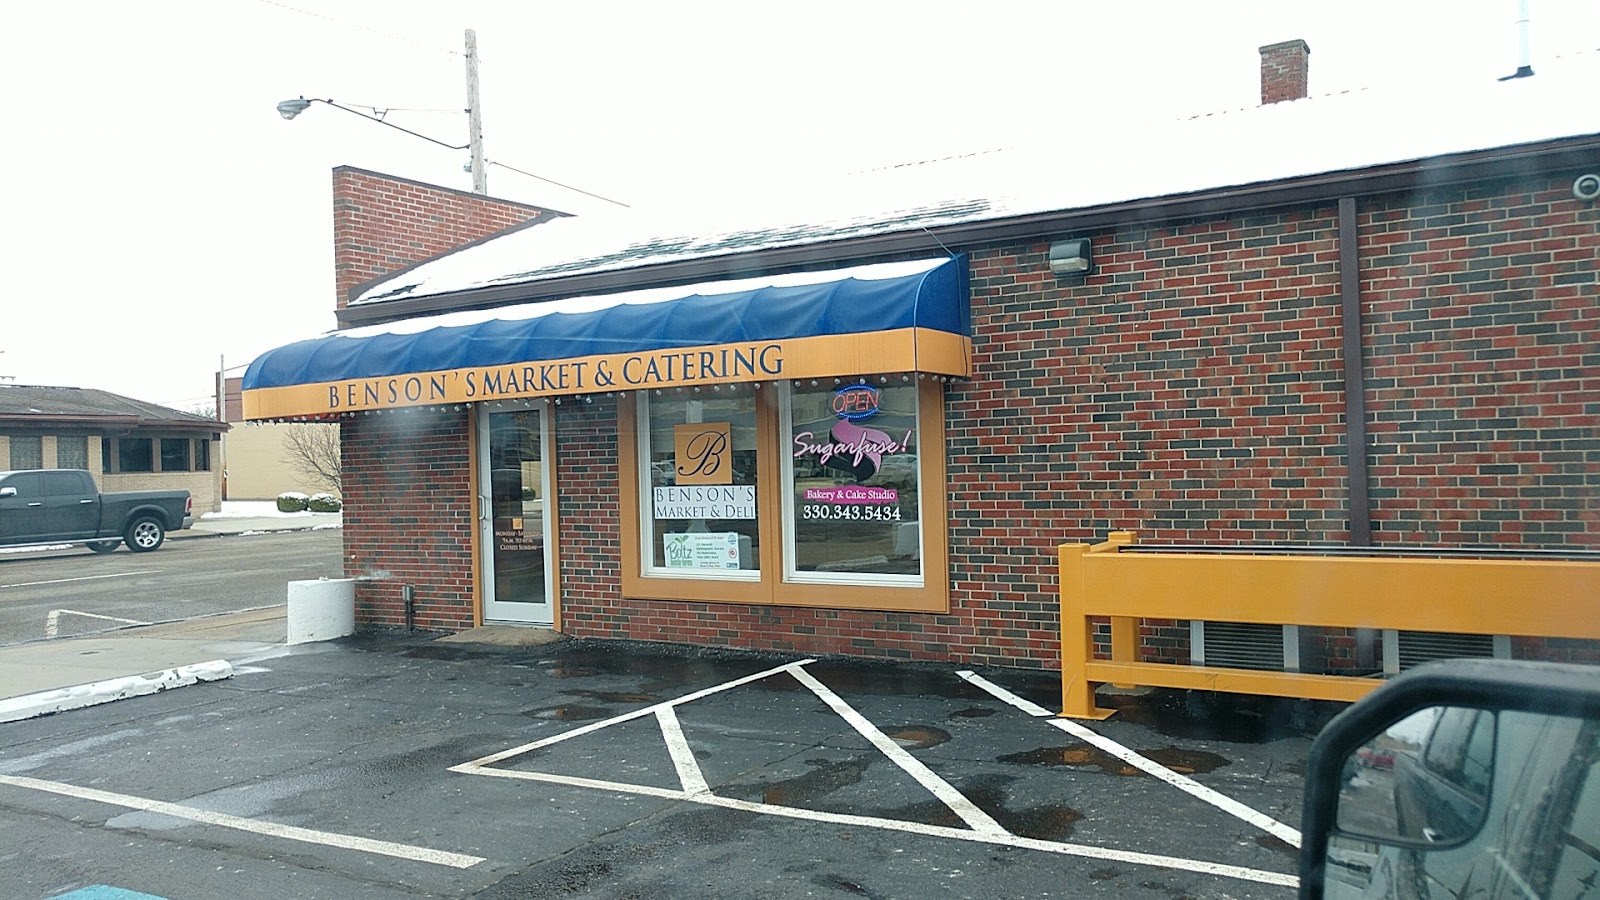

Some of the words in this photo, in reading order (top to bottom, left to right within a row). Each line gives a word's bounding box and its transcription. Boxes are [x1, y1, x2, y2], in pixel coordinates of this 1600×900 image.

[329, 371, 476, 408] BENSON'S
[482, 361, 588, 396] MARKET
[594, 359, 617, 387] &
[622, 344, 784, 384] CATERING
[832, 390, 880, 413] OPEN
[656, 487, 754, 502] BENSON'S
[807, 489, 835, 501] Bakery
[836, 490, 844, 499] &
[845, 489, 867, 500] Cake
[867, 489, 896, 500] Studio
[710, 504, 721, 518] &
[803, 504, 902, 521] 330.343.5434
